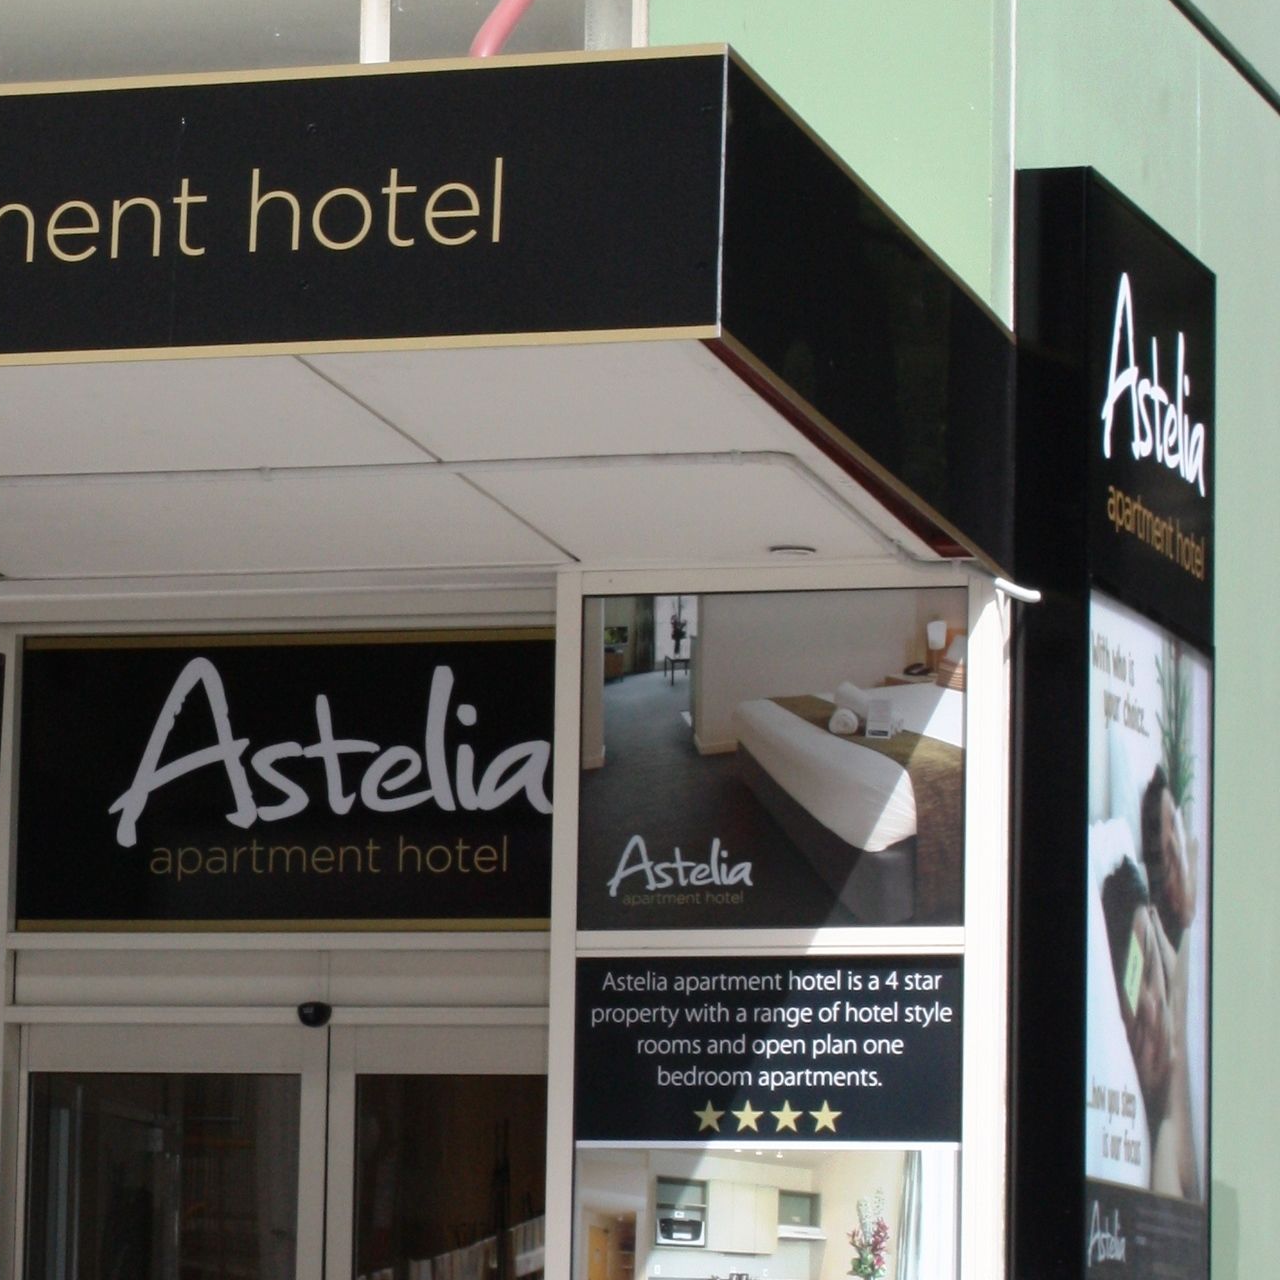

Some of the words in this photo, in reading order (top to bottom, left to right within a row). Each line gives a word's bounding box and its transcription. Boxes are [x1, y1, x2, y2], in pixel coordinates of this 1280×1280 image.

[248, 157, 505, 253] hotel
[1101, 272, 1206, 497] Astelia
[1107, 484, 1174, 558] apartment
[1176, 526, 1206, 582] hotel
[108, 656, 555, 848] Astelia
[149, 837, 381, 881] apartment
[398, 834, 509, 874] hotel
[606, 834, 754, 898] Astelia
[622, 891, 702, 907] apartment
[705, 888, 745, 905] hotel
[602, 971, 668, 991] Astelia
[674, 971, 782, 996] apartment
[789, 970, 841, 990] hotel
[847, 971, 862, 990] is
[869, 975, 879, 991] a
[885, 971, 899, 990] 4
[904, 971, 943, 991] star
[591, 1004, 679, 1027] property
[685, 1002, 730, 1022] with
[736, 1007, 747, 1022] a
[753, 1006, 813, 1028] range
[818, 1001, 841, 1022] of
[845, 1002, 899, 1022] hotel
[904, 1002, 953, 1028] style
[637, 1038, 701, 1055] rooms
[707, 1034, 746, 1055] and
[752, 1038, 806, 1059] open
[812, 1034, 857, 1059] plan
[862, 1038, 904, 1055] one
[657, 1066, 753, 1086] bedroom
[758, 1068, 883, 1091] apartments.
